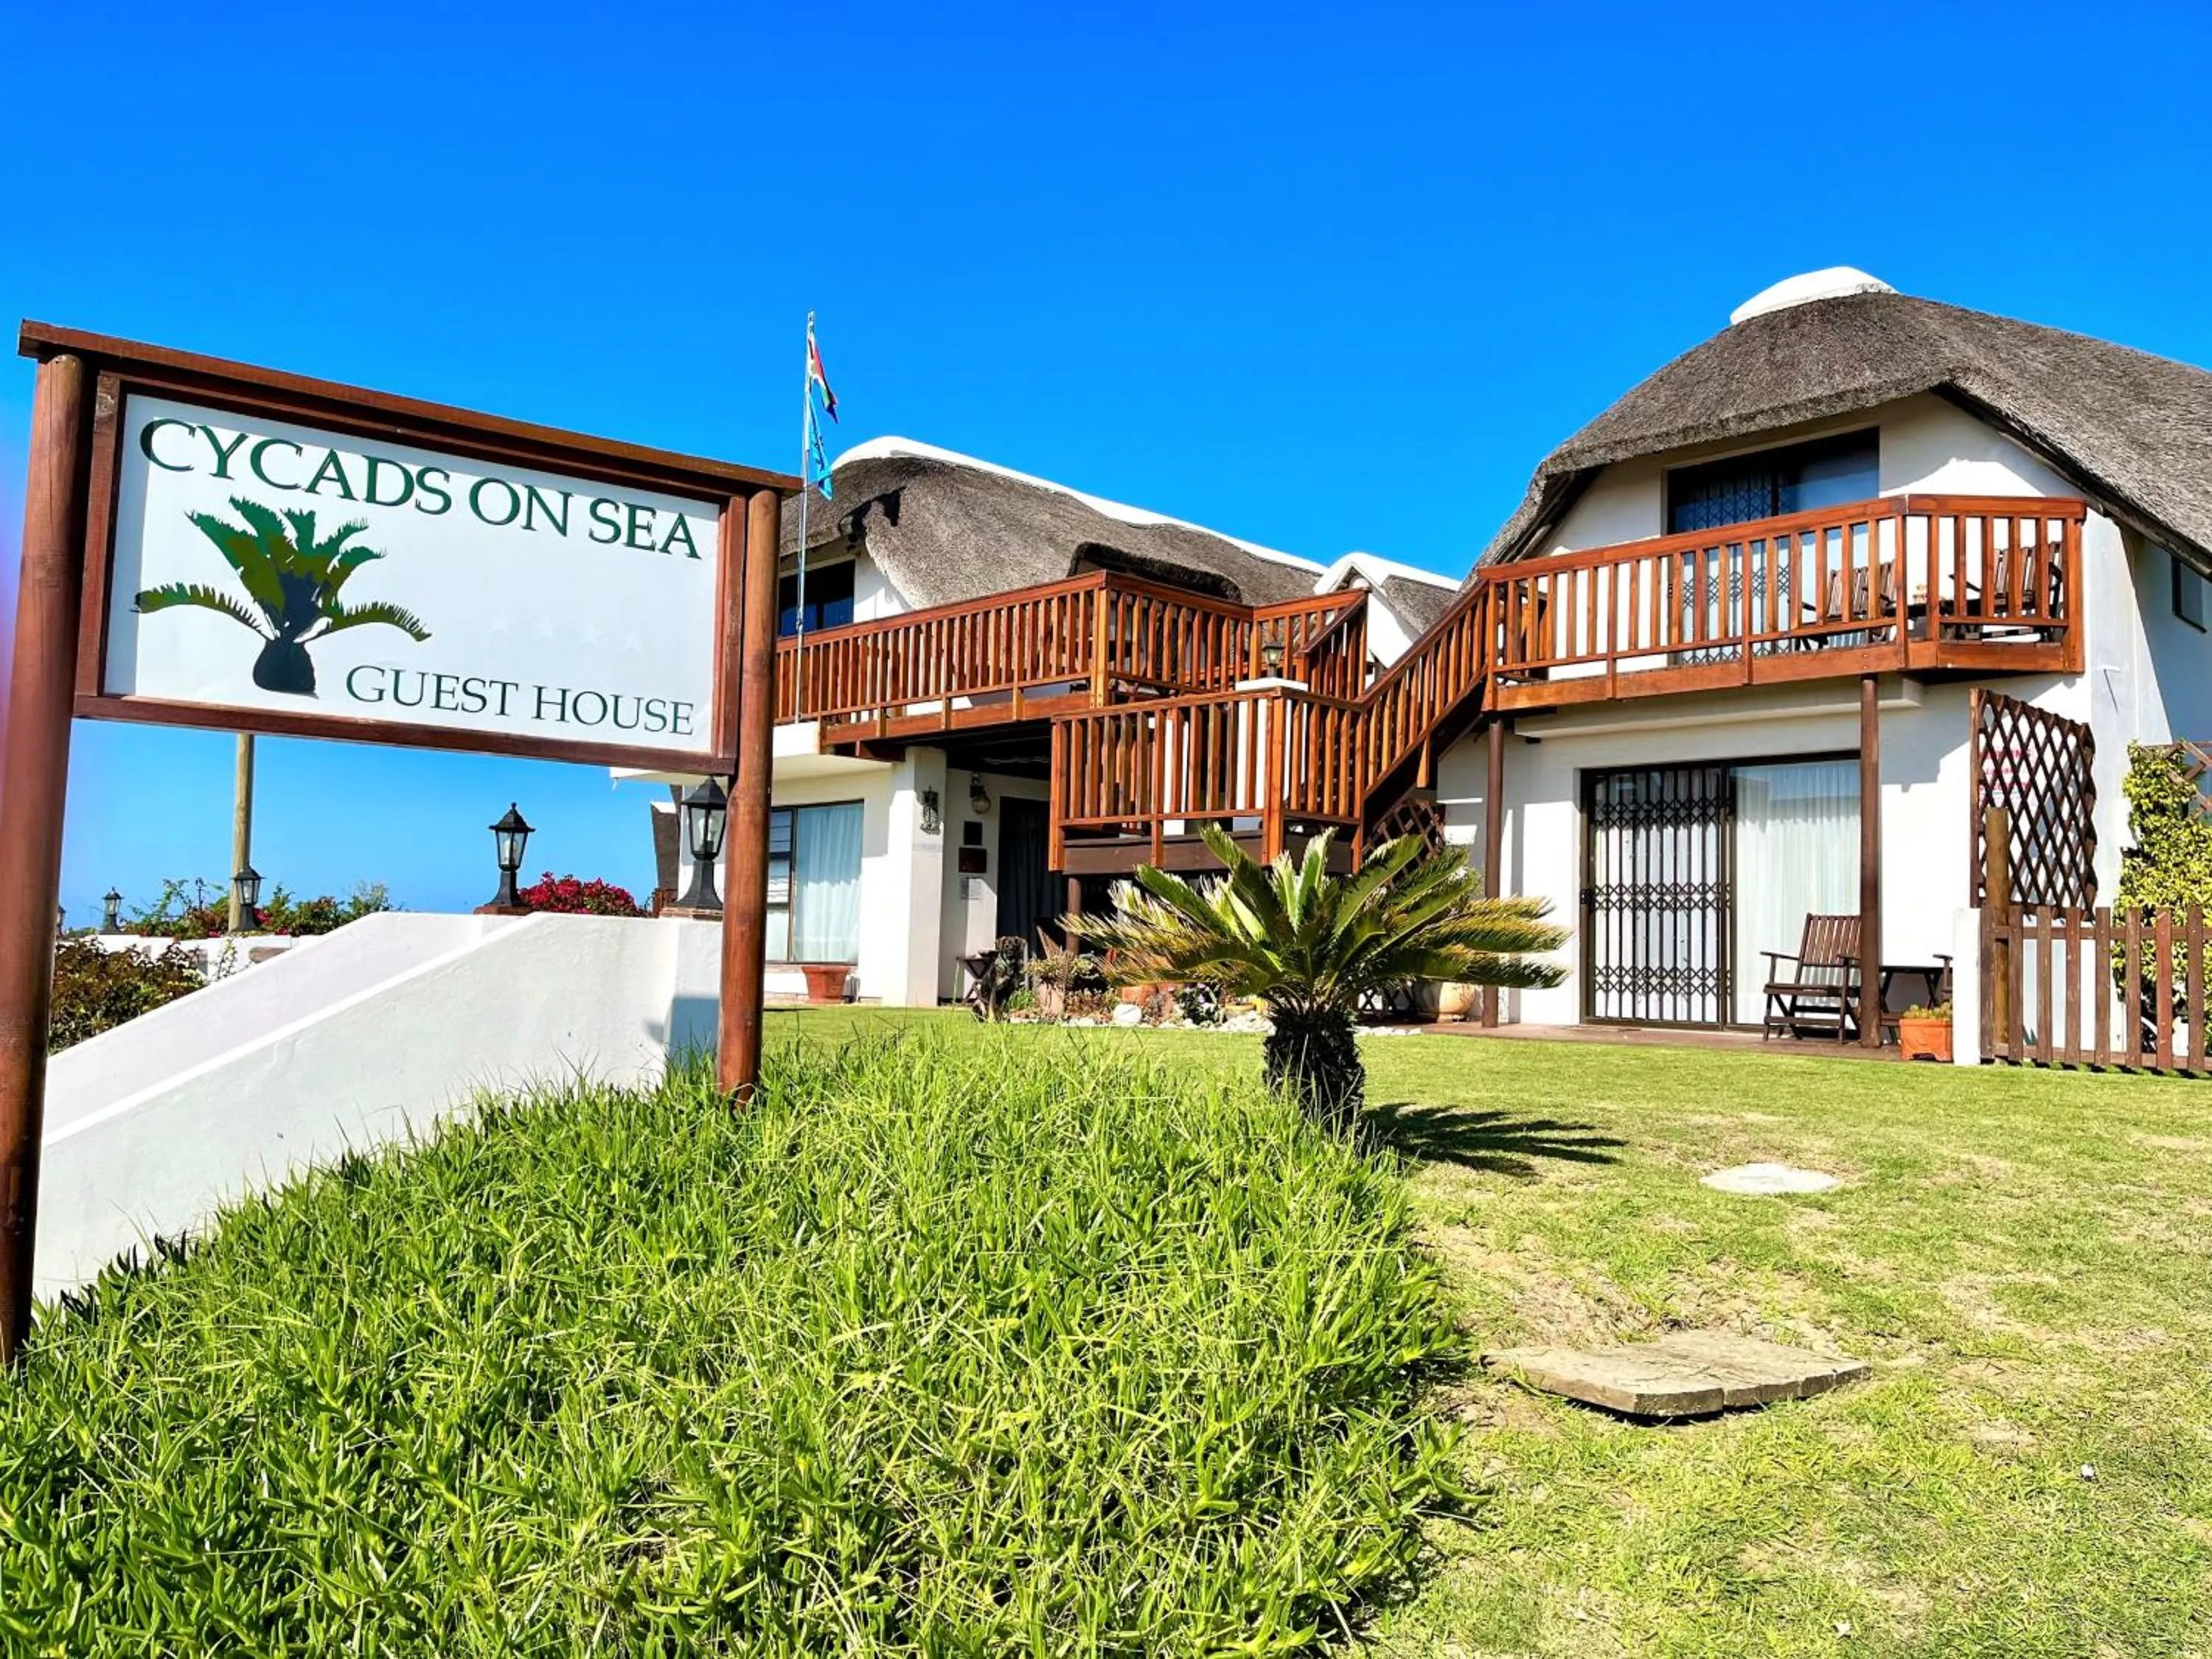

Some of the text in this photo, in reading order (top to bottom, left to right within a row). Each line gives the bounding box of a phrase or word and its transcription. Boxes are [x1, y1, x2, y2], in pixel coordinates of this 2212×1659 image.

[139, 418, 701, 560] CYCADS ON SEA
[346, 665, 695, 735] GUEST HOUSE
